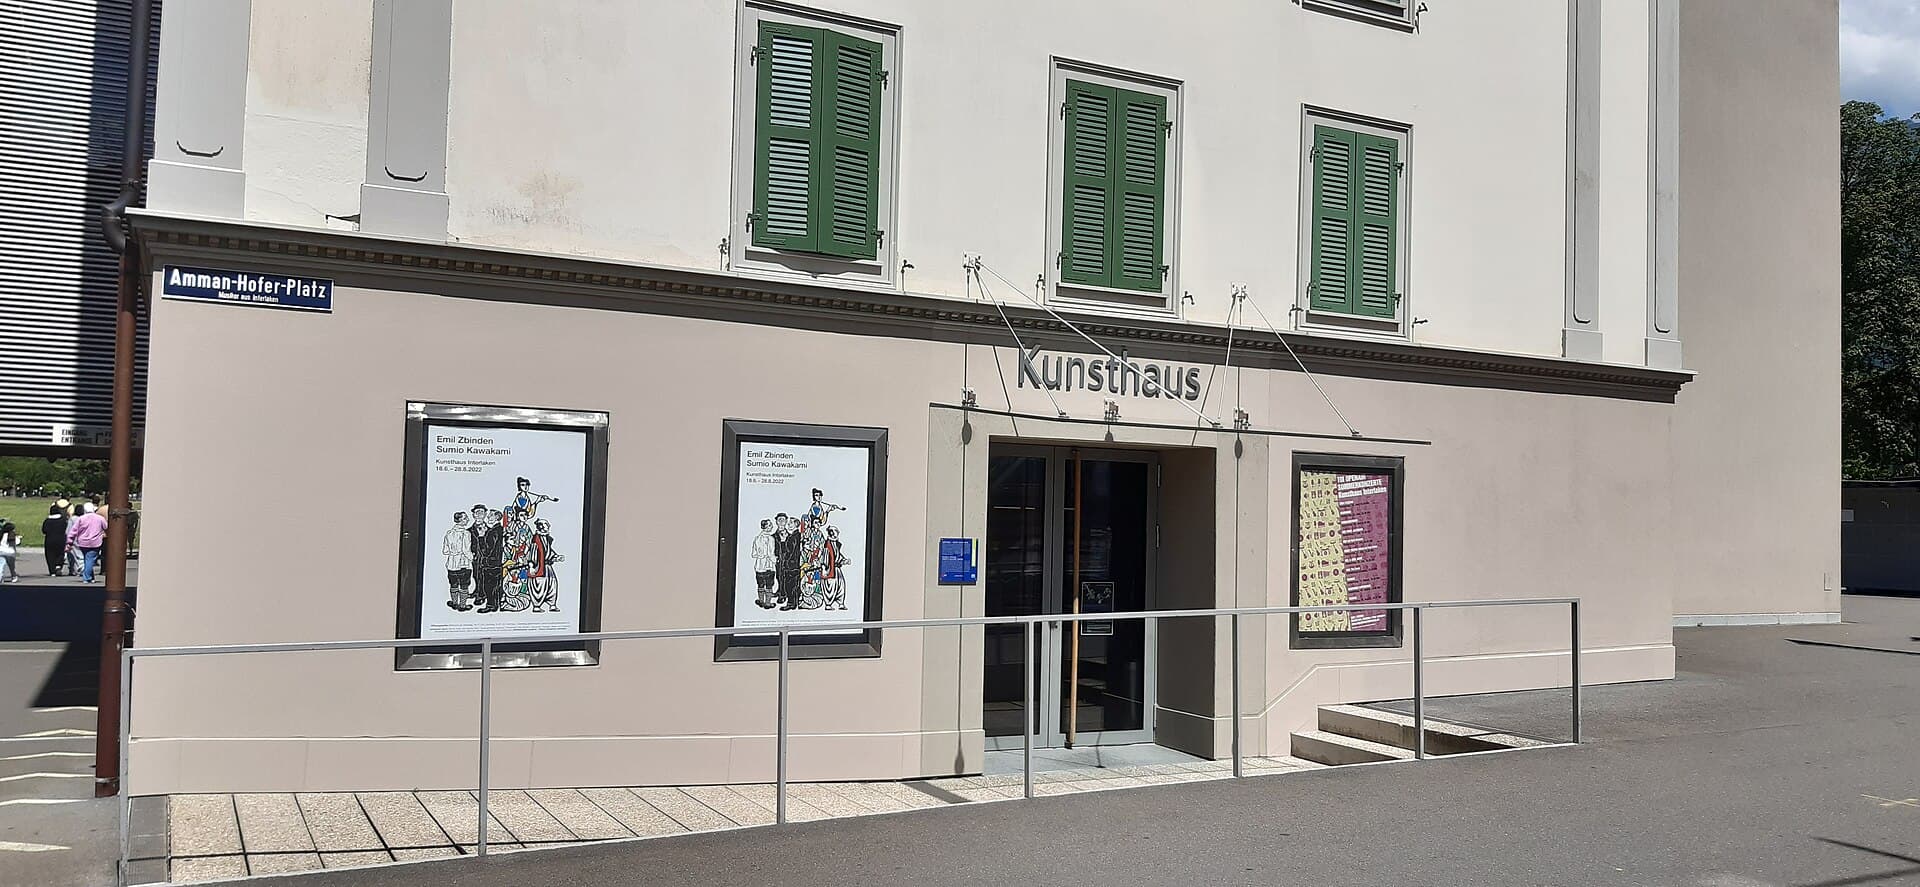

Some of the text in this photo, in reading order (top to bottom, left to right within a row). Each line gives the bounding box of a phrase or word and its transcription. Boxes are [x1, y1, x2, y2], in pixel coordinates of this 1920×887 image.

[170, 268, 326, 299] Amman-Hofer-Platz
[1017, 343, 1201, 401] Kunsthaus
[436, 435, 494, 445] Emil Zbinden
[436, 445, 511, 455] Sumio Kawakami
[747, 450, 794, 459] Emil Zbinden
[746, 459, 808, 469] Sumio Kawakami
